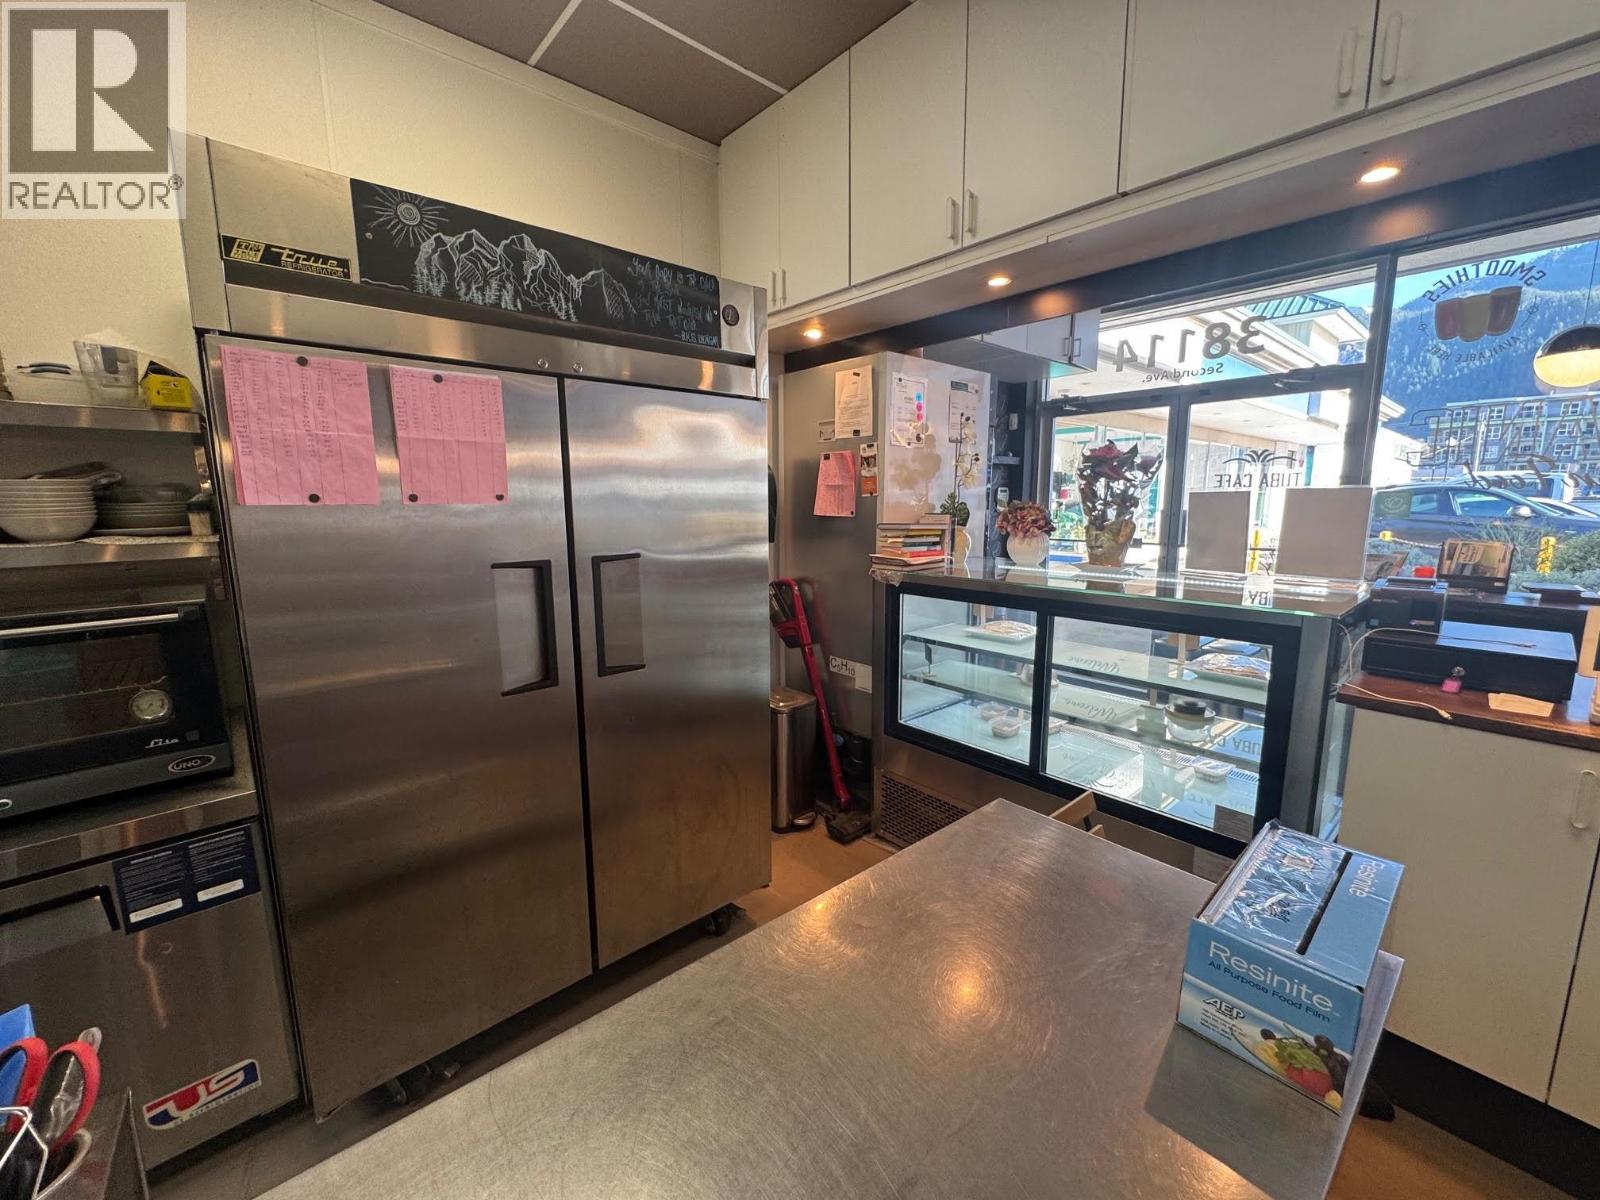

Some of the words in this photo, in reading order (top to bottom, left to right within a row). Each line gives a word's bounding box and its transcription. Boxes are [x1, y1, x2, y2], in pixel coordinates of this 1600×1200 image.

[280, 260, 345, 278] REFRIGERATOR
[1348, 858, 1386, 899] Resinite
[1208, 940, 1334, 1012] Resinite
[1208, 959, 1222, 971] All
[1223, 966, 1269, 995] Purpose
[1272, 990, 1302, 1010] Food
[1305, 1005, 1331, 1024] Film
[1202, 997, 1246, 1019] AEP
